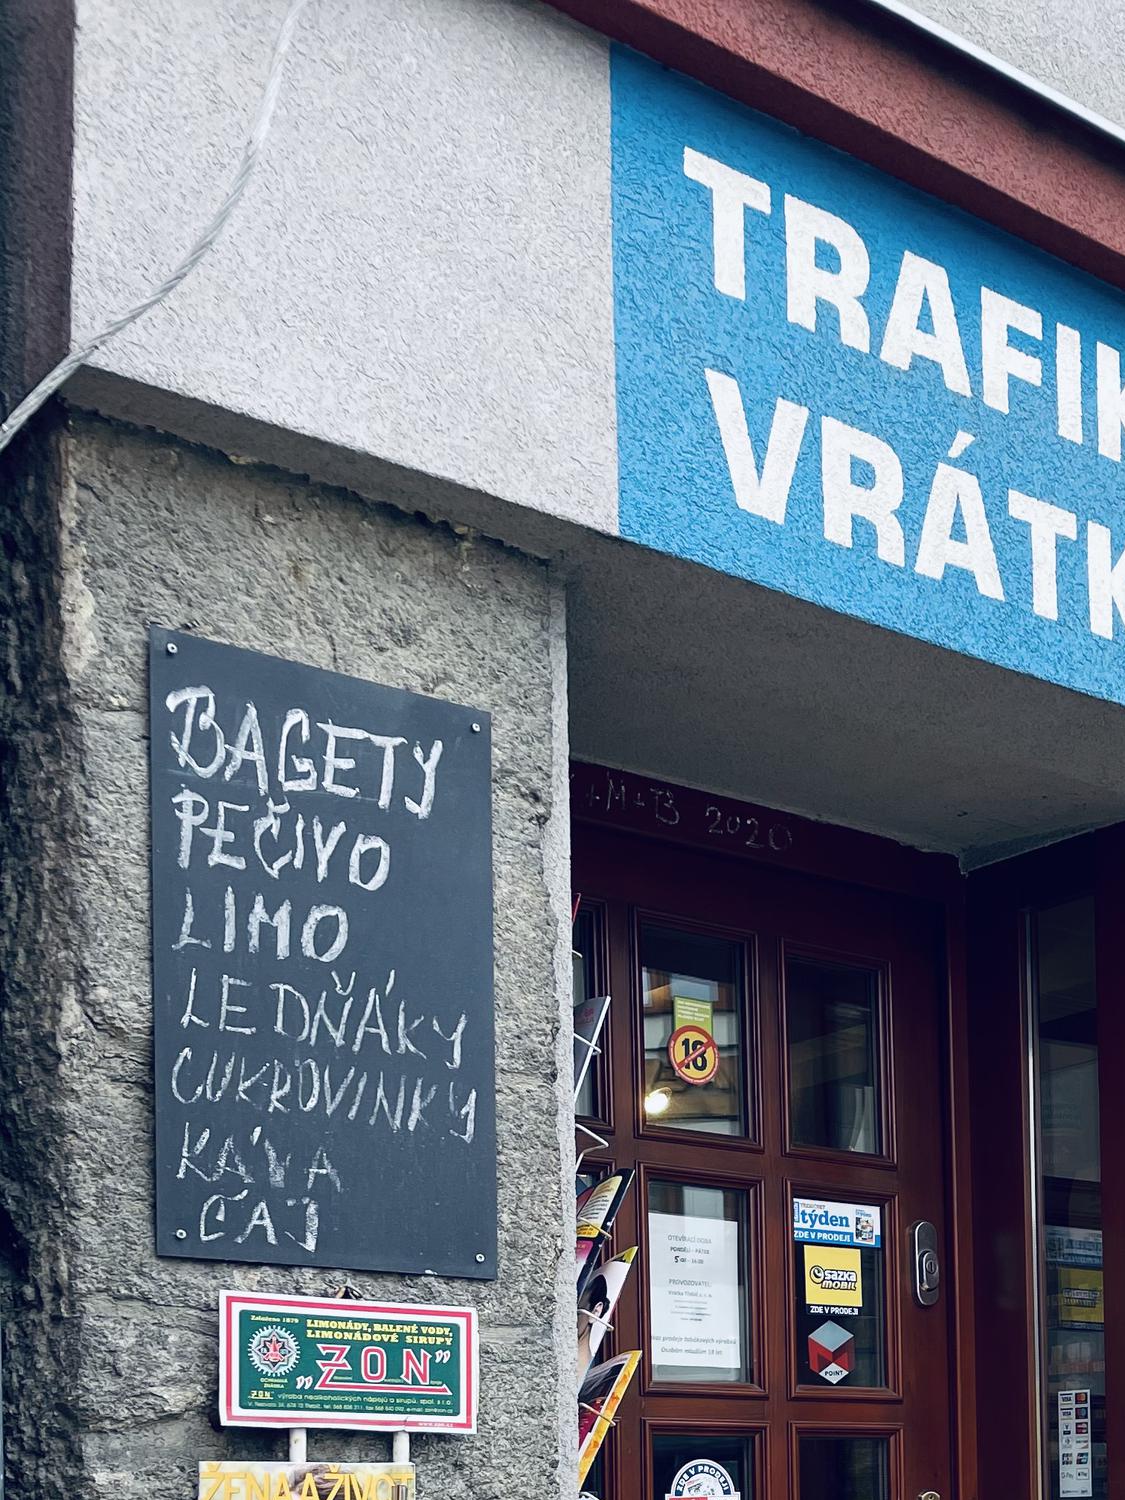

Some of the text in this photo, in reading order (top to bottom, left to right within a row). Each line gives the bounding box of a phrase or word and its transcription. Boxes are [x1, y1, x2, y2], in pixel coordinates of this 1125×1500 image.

[166, 685, 444, 820] BAGETY
[171, 783, 391, 891] PEČIVO
[705, 806, 793, 851] 2020
[171, 886, 349, 962] LIMO
[181, 967, 469, 1070] LEDŇÁKY
[681, 1037, 708, 1071] 18
[171, 1047, 479, 1144] CUKROVINKY
[175, 1122, 344, 1194] KÁVA
[199, 1189, 321, 1253] ČAJ
[794, 1230, 809, 1239] ZDE
[817, 1232, 851, 1243] PRODEJI
[801, 1206, 850, 1229] týden
[306, 1318, 453, 1336] LIMONÁDY, BALENÉ VODY,
[810, 1305, 823, 1314] ZDE
[831, 1307, 858, 1316] PRODEJI
[306, 1329, 453, 1346] LIMONÁDOVÉ SIRUPY
[824, 1369, 844, 1377] POINT
[278, 1393, 303, 1401] výroba
[362, 1395, 388, 1404] nápojů
